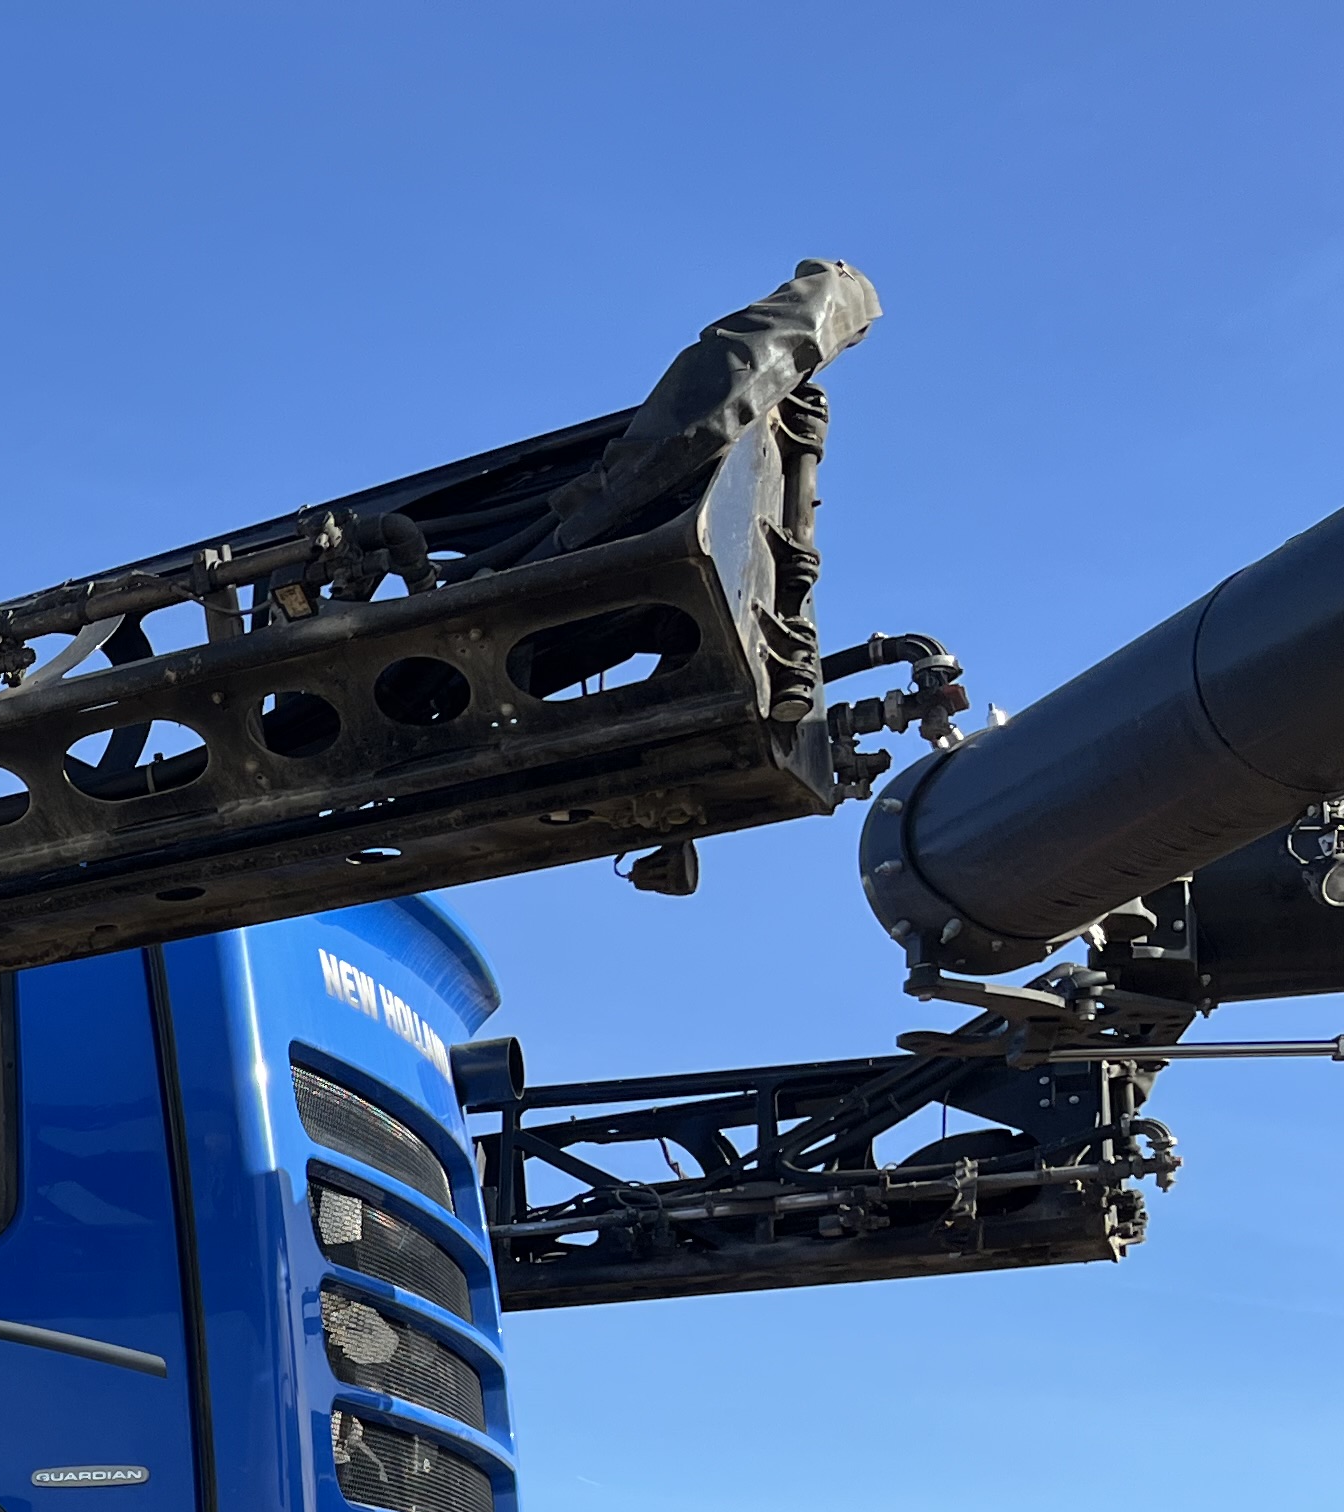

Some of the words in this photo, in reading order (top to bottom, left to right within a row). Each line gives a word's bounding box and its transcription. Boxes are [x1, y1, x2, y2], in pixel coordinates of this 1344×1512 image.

[317, 947, 379, 1023] NEW
[378, 983, 452, 1087] HOLLAND
[36, 1470, 142, 1482] GUARDIAN
